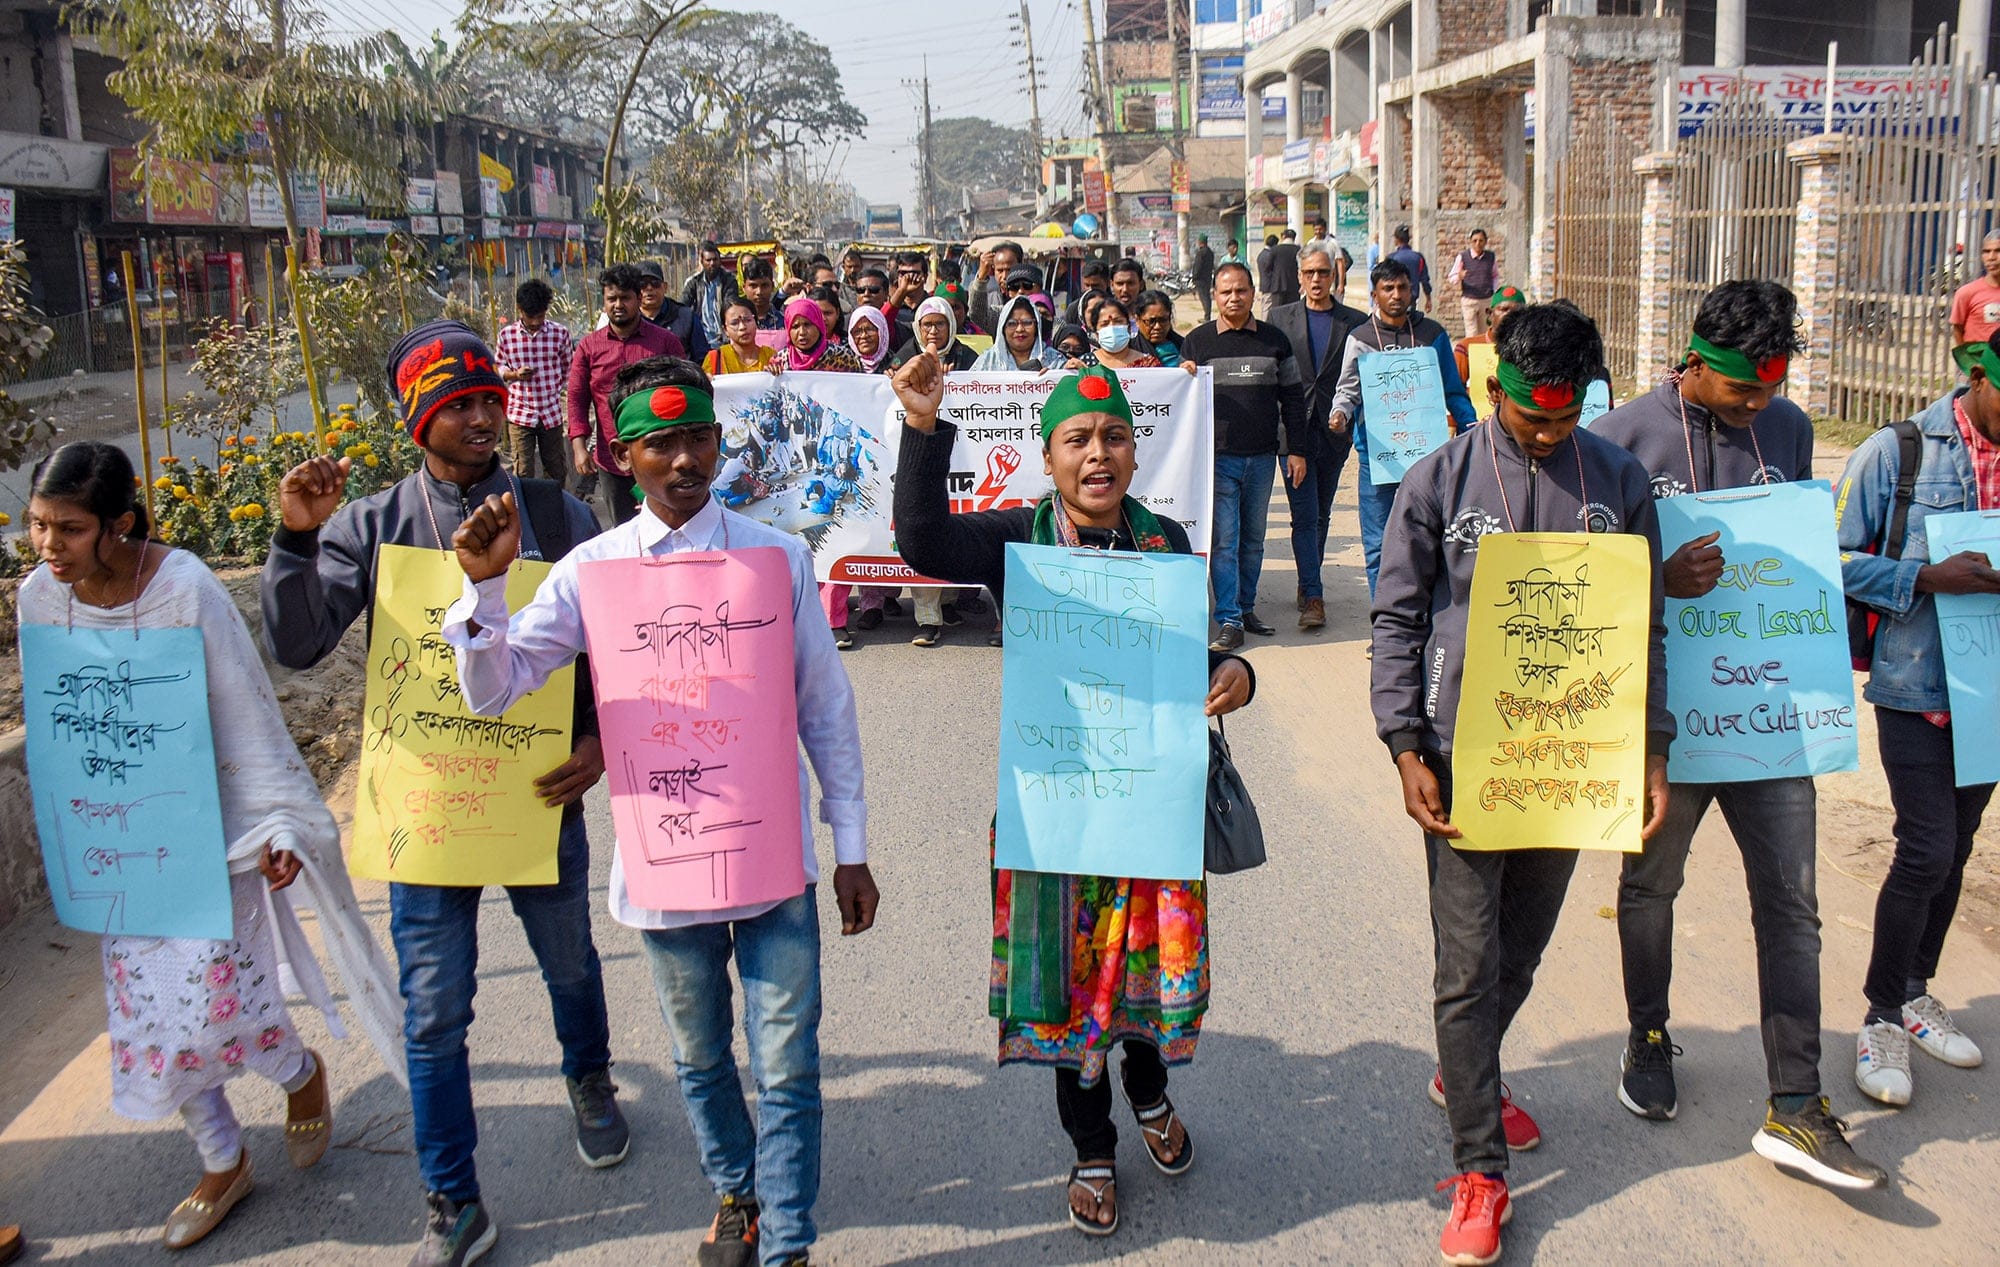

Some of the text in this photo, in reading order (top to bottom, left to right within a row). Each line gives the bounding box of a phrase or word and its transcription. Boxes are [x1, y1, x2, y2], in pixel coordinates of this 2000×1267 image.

[944, 380, 1001, 395] দিবাসীদের
[947, 402, 1024, 421] আদিবাসী
[1130, 400, 1171, 417] উপর
[966, 427, 1024, 443] হামলার
[1033, 560, 1157, 607] আমি
[1495, 564, 1591, 617] আদিবাসী
[1717, 558, 1794, 592] ave
[621, 601, 765, 669] আদিবাসী
[1005, 600, 1180, 653] আদিবাসী
[1426, 647, 1446, 718] SOUTH WALES
[1711, 655, 1789, 687] Save
[1064, 667, 1127, 718] এটা
[1014, 720, 1138, 756] আমার
[1021, 760, 1156, 802] পরিচয়
